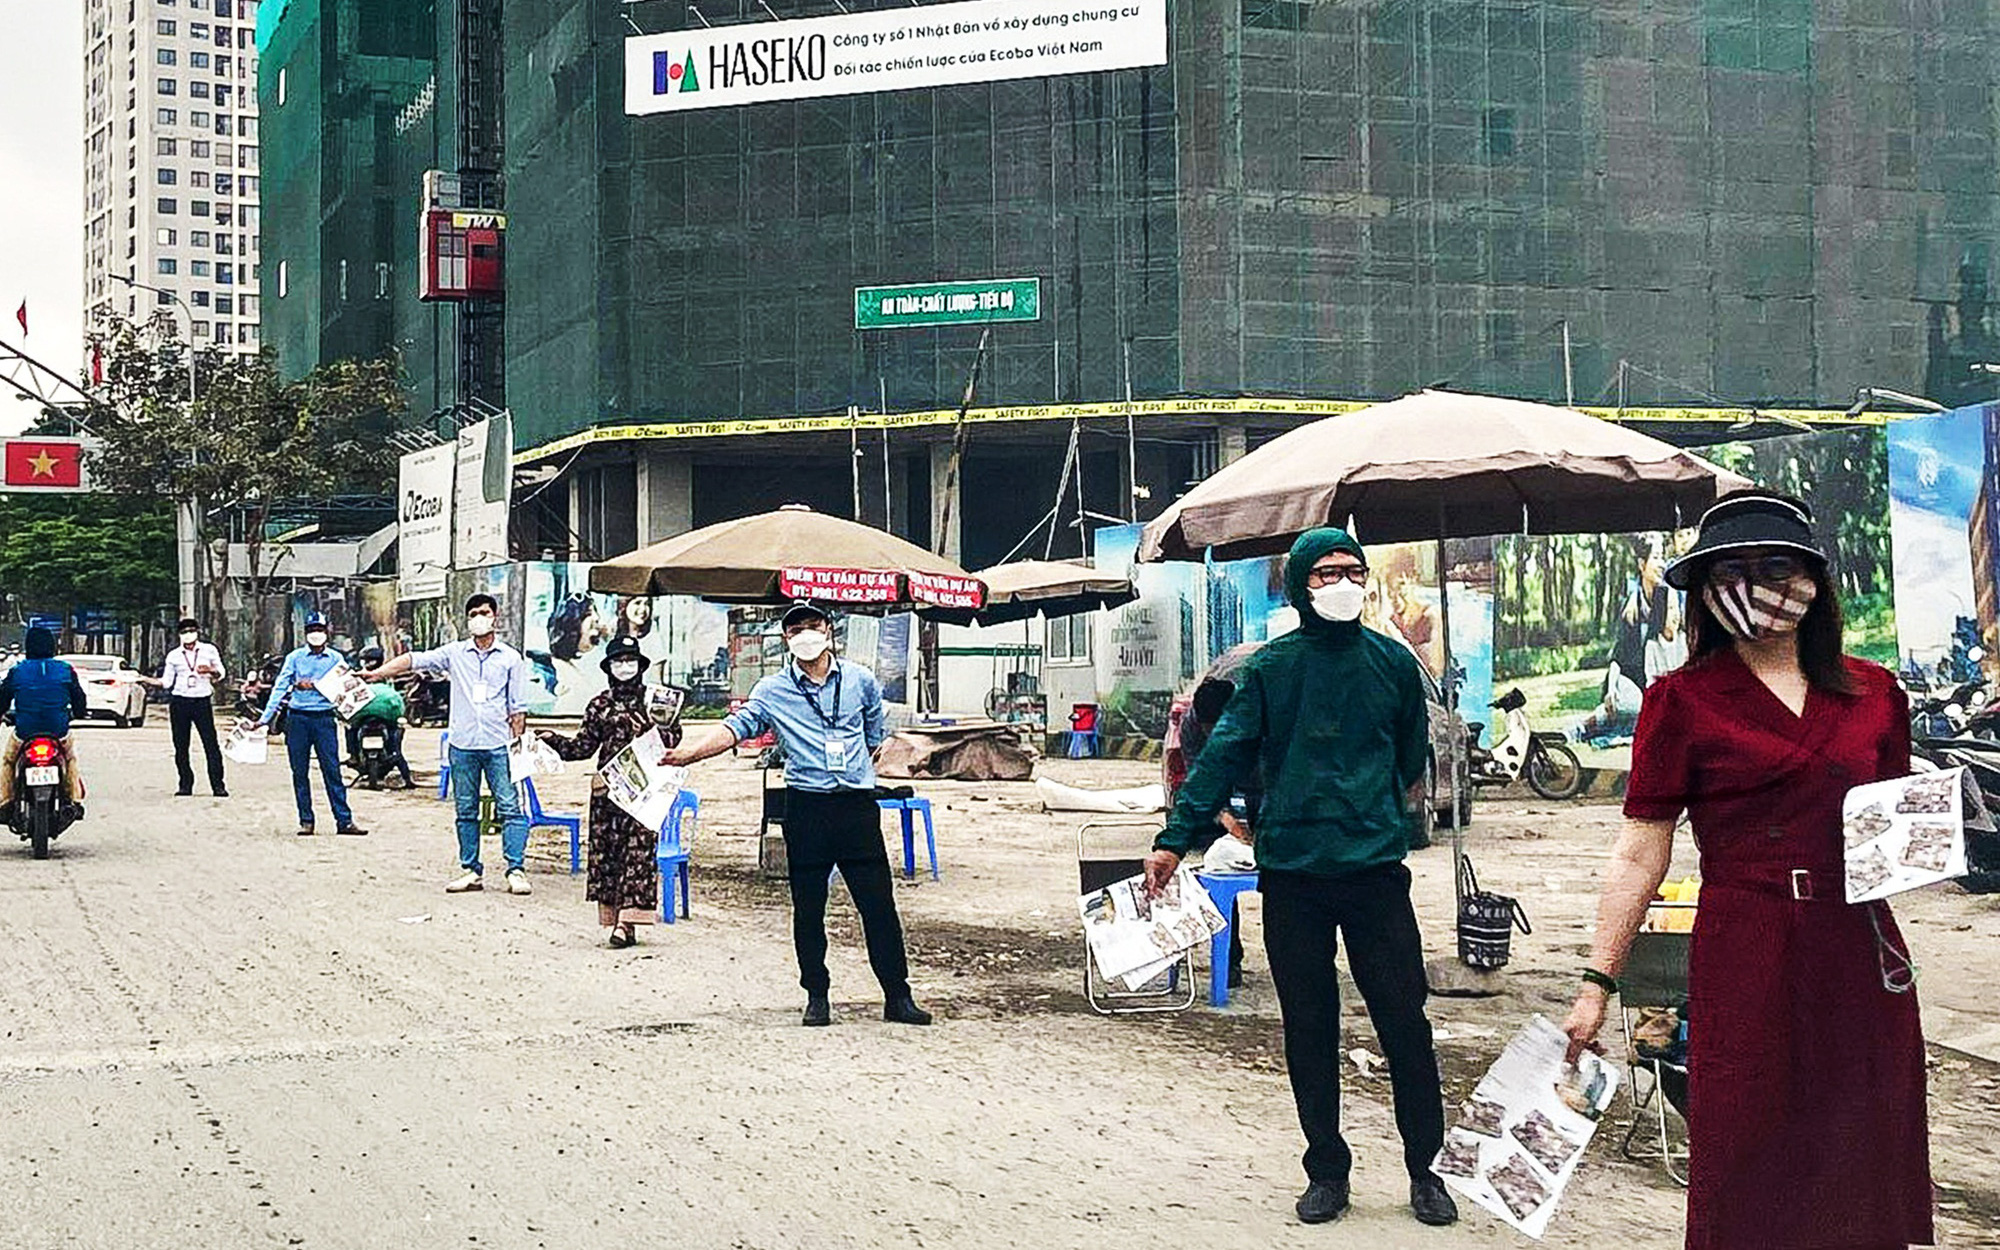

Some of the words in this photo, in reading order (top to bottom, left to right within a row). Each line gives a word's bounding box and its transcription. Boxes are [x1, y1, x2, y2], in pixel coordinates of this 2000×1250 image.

[833, 33, 869, 48] Công
[873, 33, 886, 46] ty
[890, 26, 905, 42] số
[908, 28, 913, 39] 1
[916, 24, 950, 40] Nhật
[953, 20, 980, 35] Bản
[1003, 16, 1029, 31] xây
[1032, 14, 1069, 28] dựng
[1072, 9, 1117, 23] chung
[1121, 5, 1140, 17] cư
[709, 34, 826, 89] HASEKO
[860, 59, 882, 74] tác
[886, 55, 923, 71] chiến
[926, 55, 956, 69] lược
[959, 50, 986, 64] của
[990, 46, 1034, 61] Ecoba
[1037, 42, 1066, 58] Việt
[1069, 41, 1103, 54] Nam
[1142, 402, 1166, 412] FIRST
[1176, 401, 1208, 411] SAFETY
[1211, 401, 1236, 411] FIRST
[883, 415, 914, 426] SAFETY
[916, 413, 938, 423] FIRST
[995, 409, 1024, 420] SAFETY
[1027, 407, 1050, 417] FIRST
[778, 420, 806, 429] SAFETY
[808, 419, 829, 428] FIRST
[816, 571, 832, 583] TƯ
